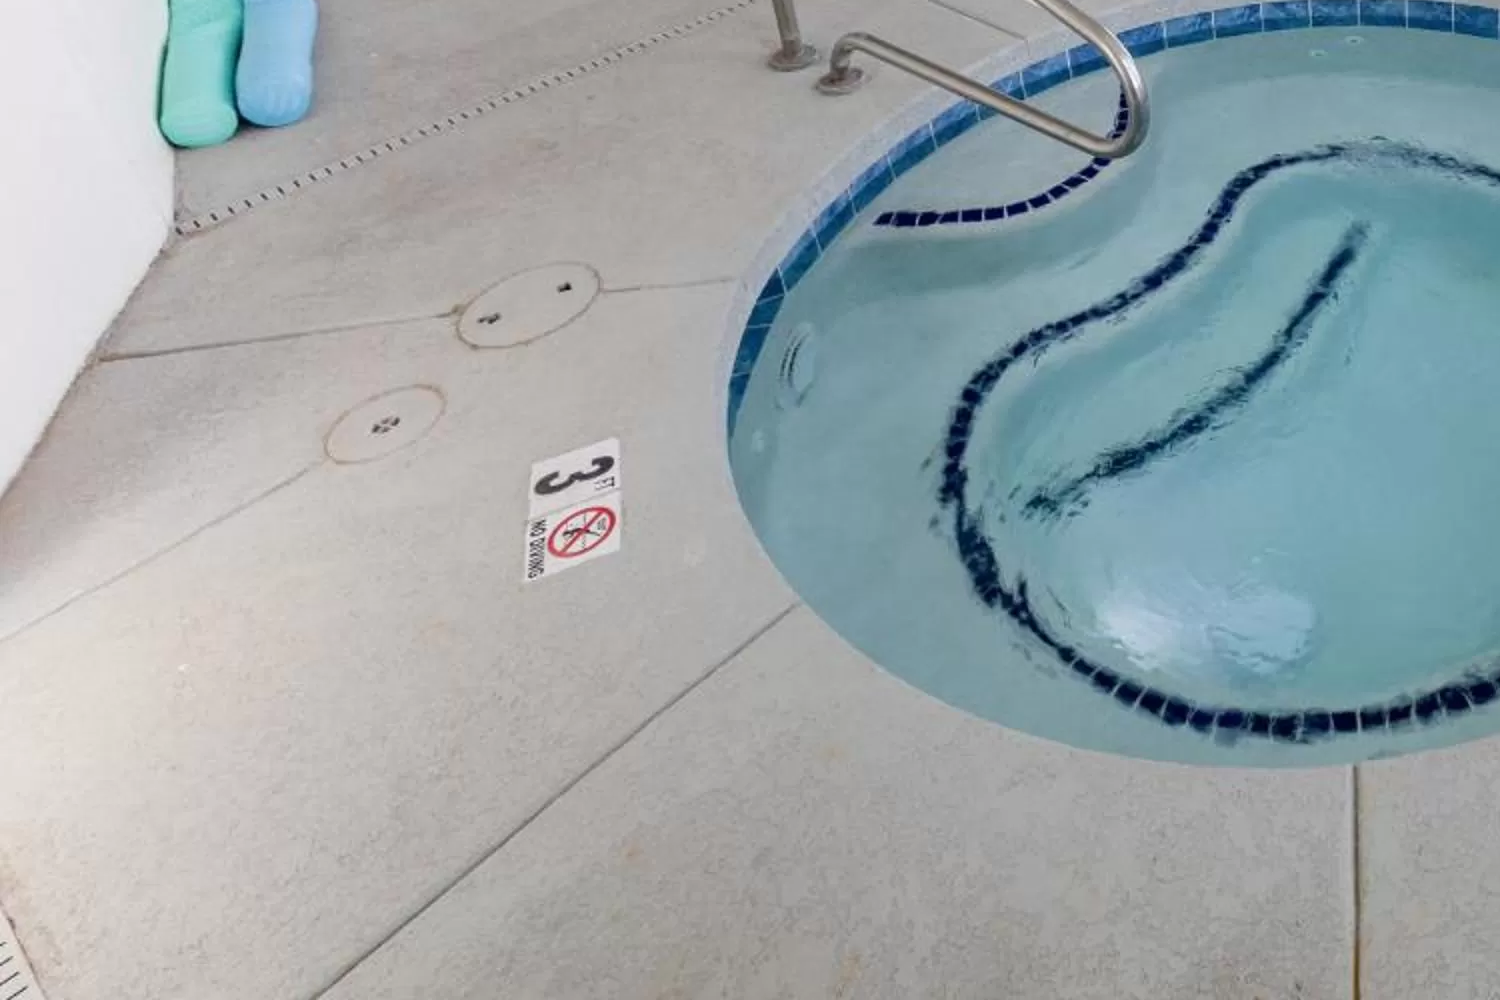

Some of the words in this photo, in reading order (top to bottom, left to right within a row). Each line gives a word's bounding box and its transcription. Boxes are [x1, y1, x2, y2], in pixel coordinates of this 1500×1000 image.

[534, 455, 615, 496] 3
[529, 518, 548, 538] NO
[527, 537, 546, 580] DIVING
